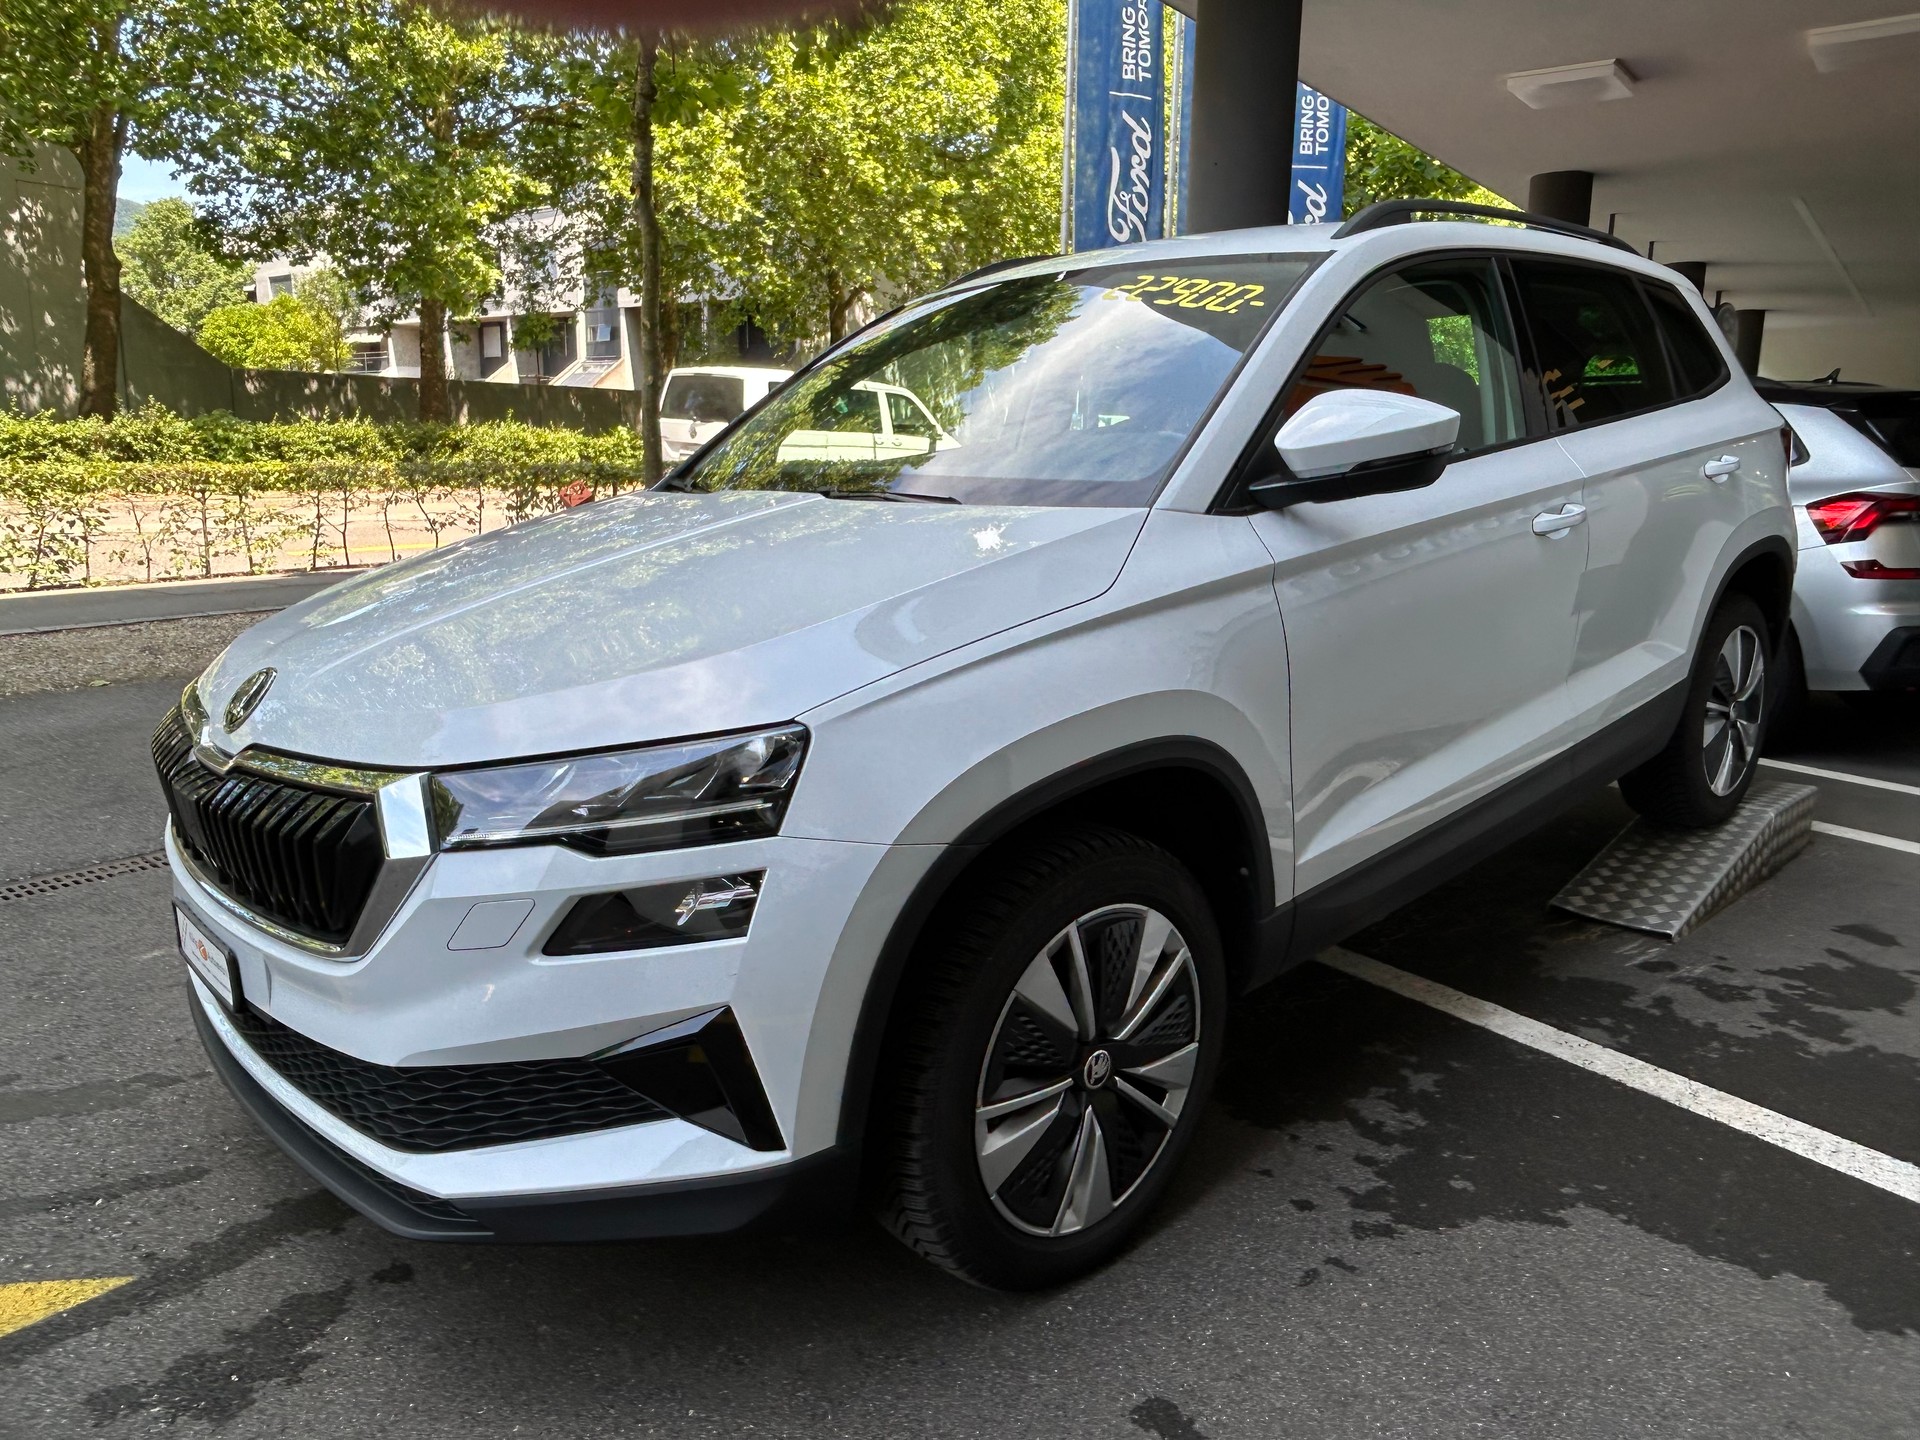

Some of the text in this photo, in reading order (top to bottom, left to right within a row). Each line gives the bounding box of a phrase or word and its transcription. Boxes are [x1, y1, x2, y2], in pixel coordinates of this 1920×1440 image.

[1122, 6, 1136, 80] BRING
[1299, 95, 1315, 155] BRING
[1315, 93, 1330, 155] TOMO
[1107, 110, 1152, 243] Ford
